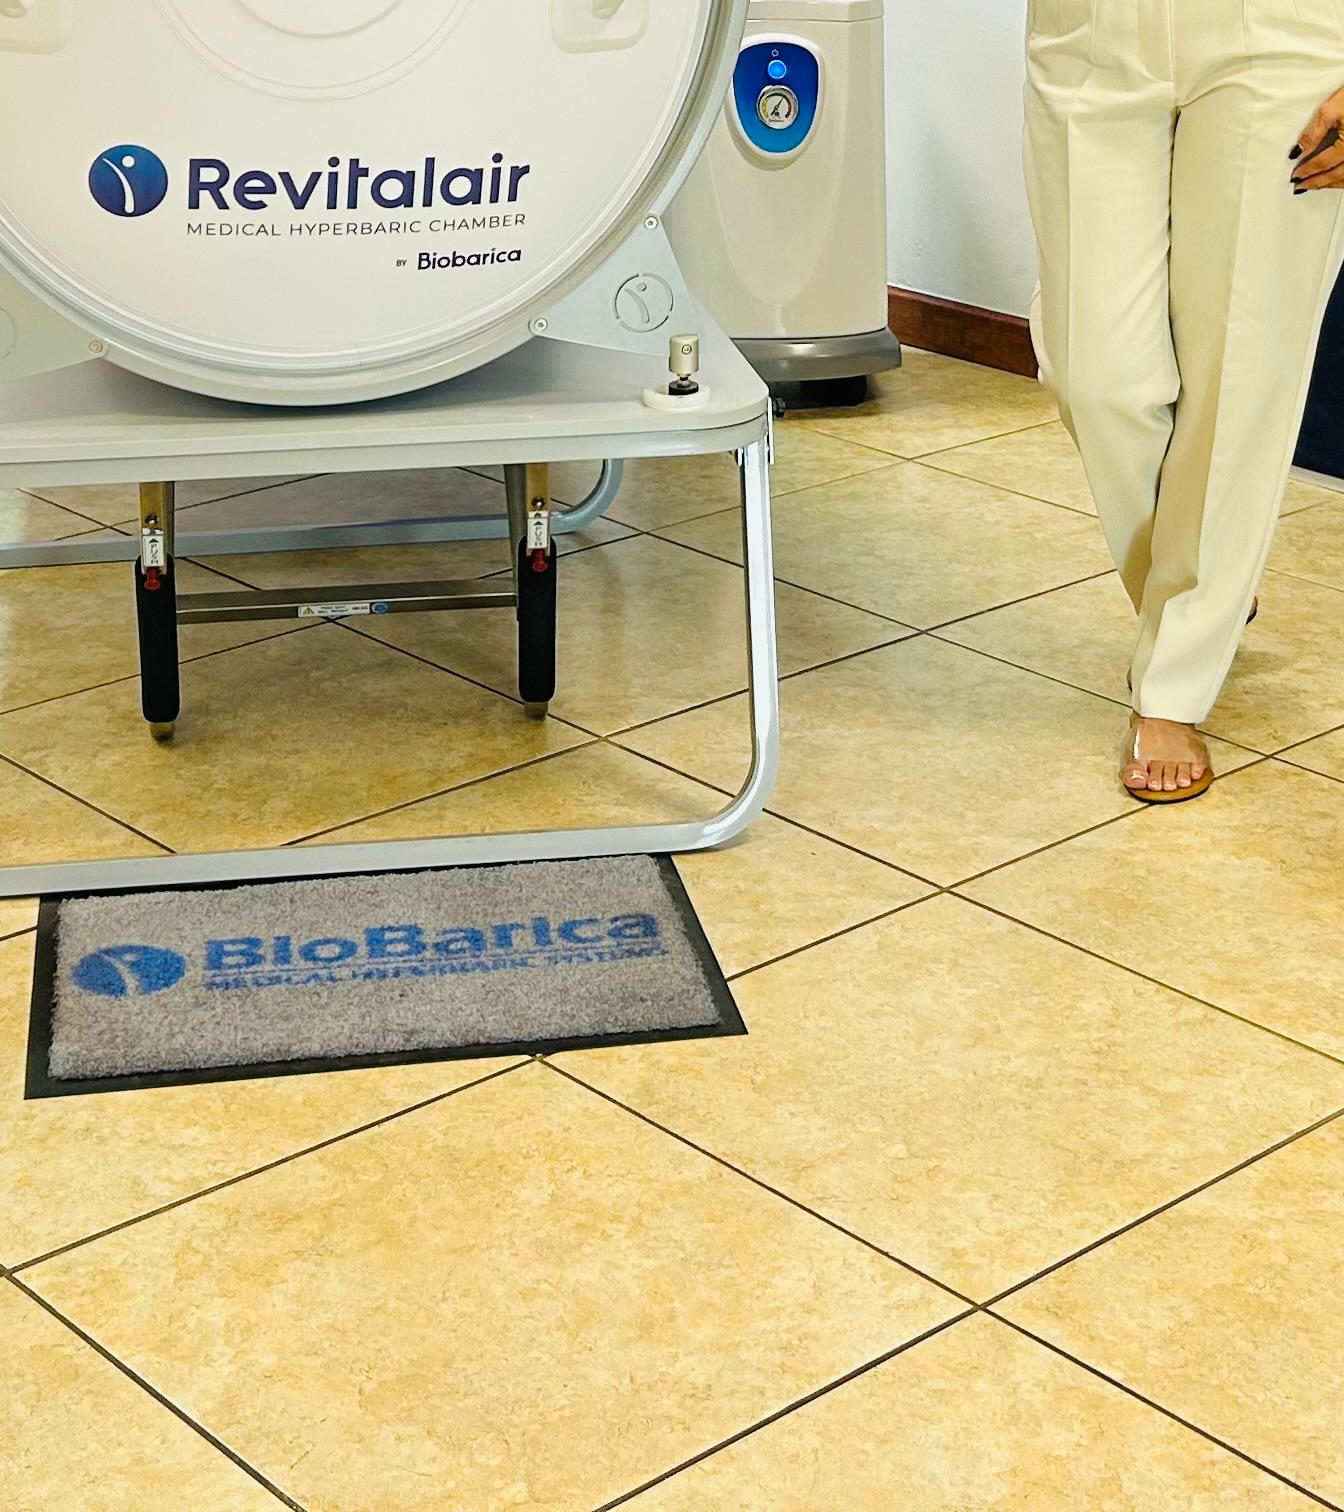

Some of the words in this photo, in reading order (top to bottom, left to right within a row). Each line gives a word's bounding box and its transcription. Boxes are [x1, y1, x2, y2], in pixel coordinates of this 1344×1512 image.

[187, 152, 531, 211] Revitalair
[186, 222, 281, 236] MEDICAL
[290, 220, 422, 236] HYPERBARIC
[428, 213, 526, 232] CHAMBER
[418, 247, 522, 271] Biobarica
[205, 912, 659, 970] BioBarica
